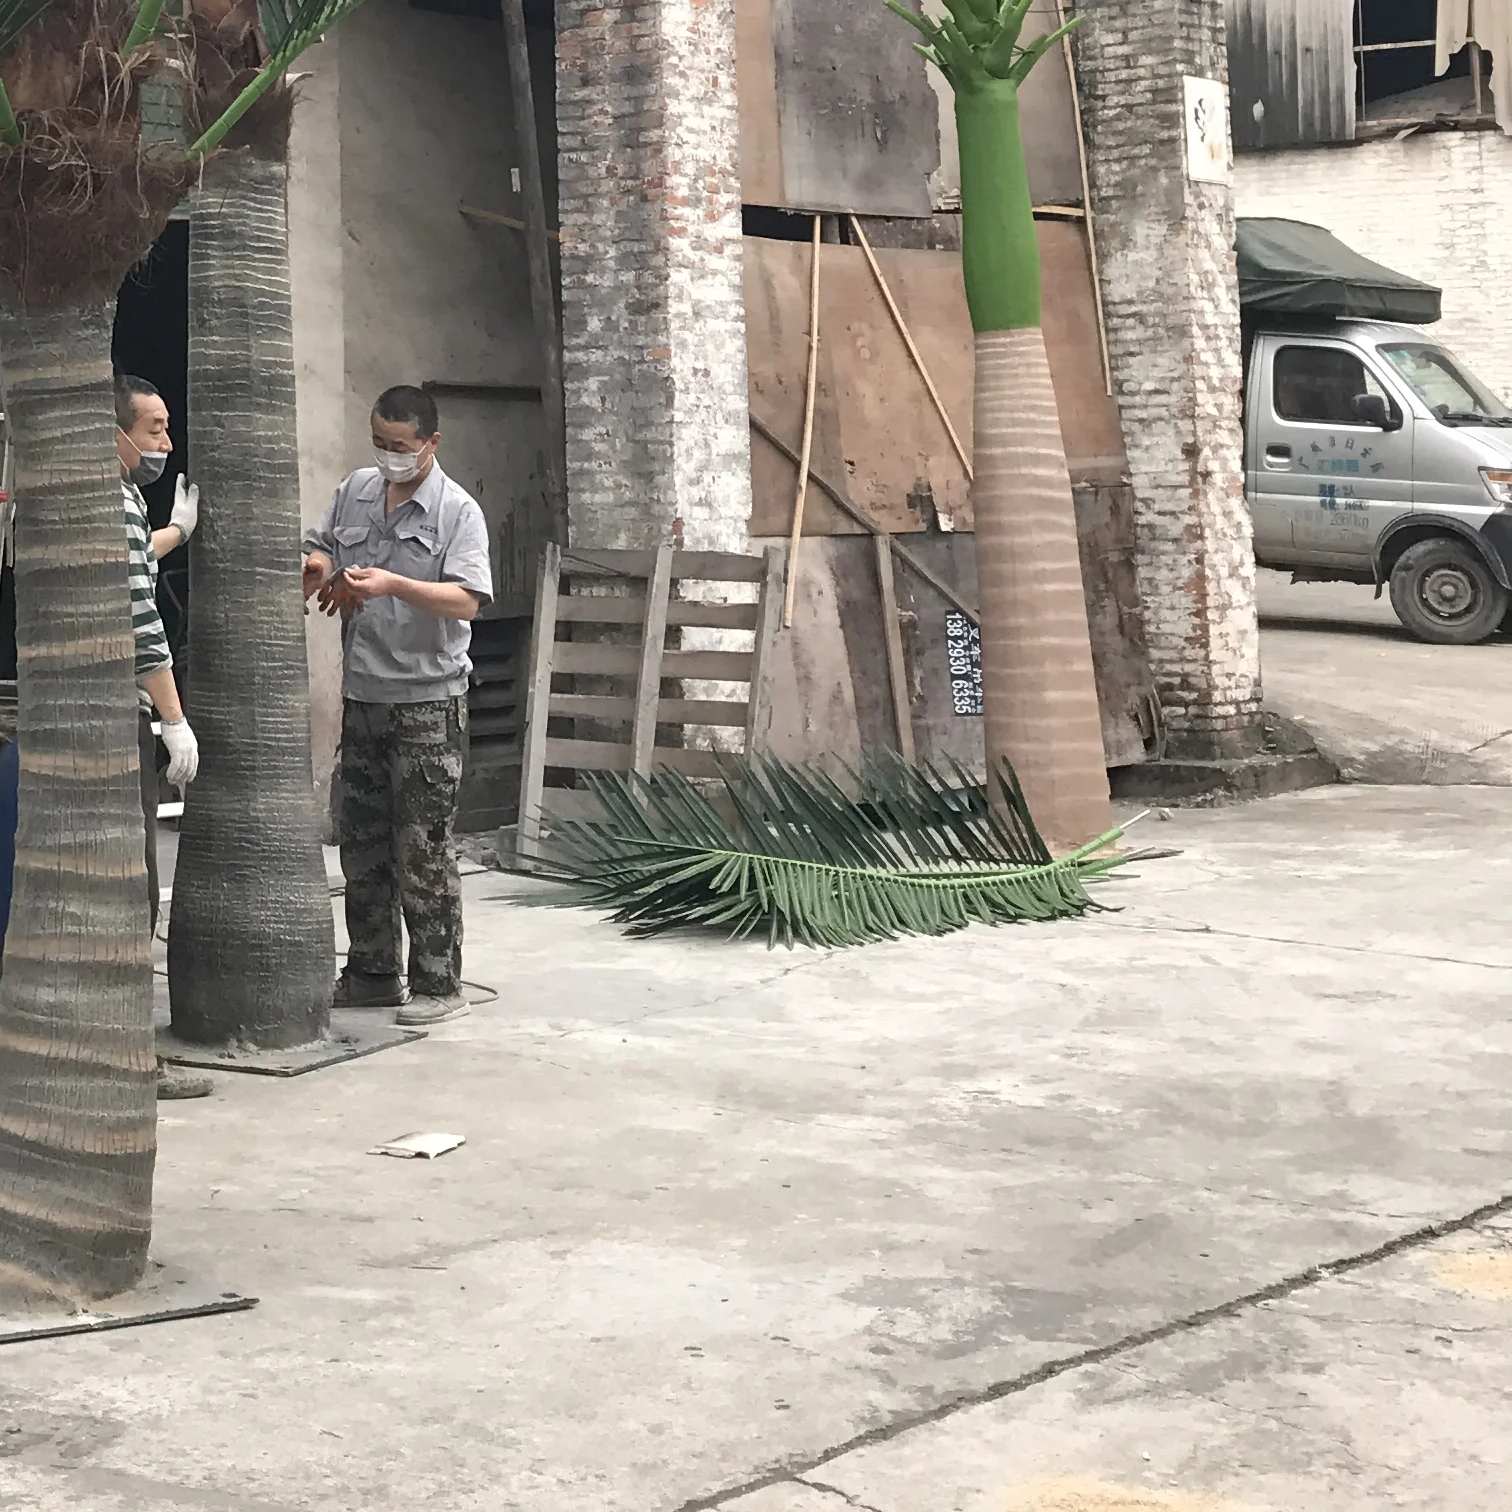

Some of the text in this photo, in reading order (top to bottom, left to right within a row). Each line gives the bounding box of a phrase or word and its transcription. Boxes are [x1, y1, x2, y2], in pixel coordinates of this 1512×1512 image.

[946, 613, 963, 636] 138
[947, 639, 967, 675] 2930
[951, 679, 972, 714] 6335
